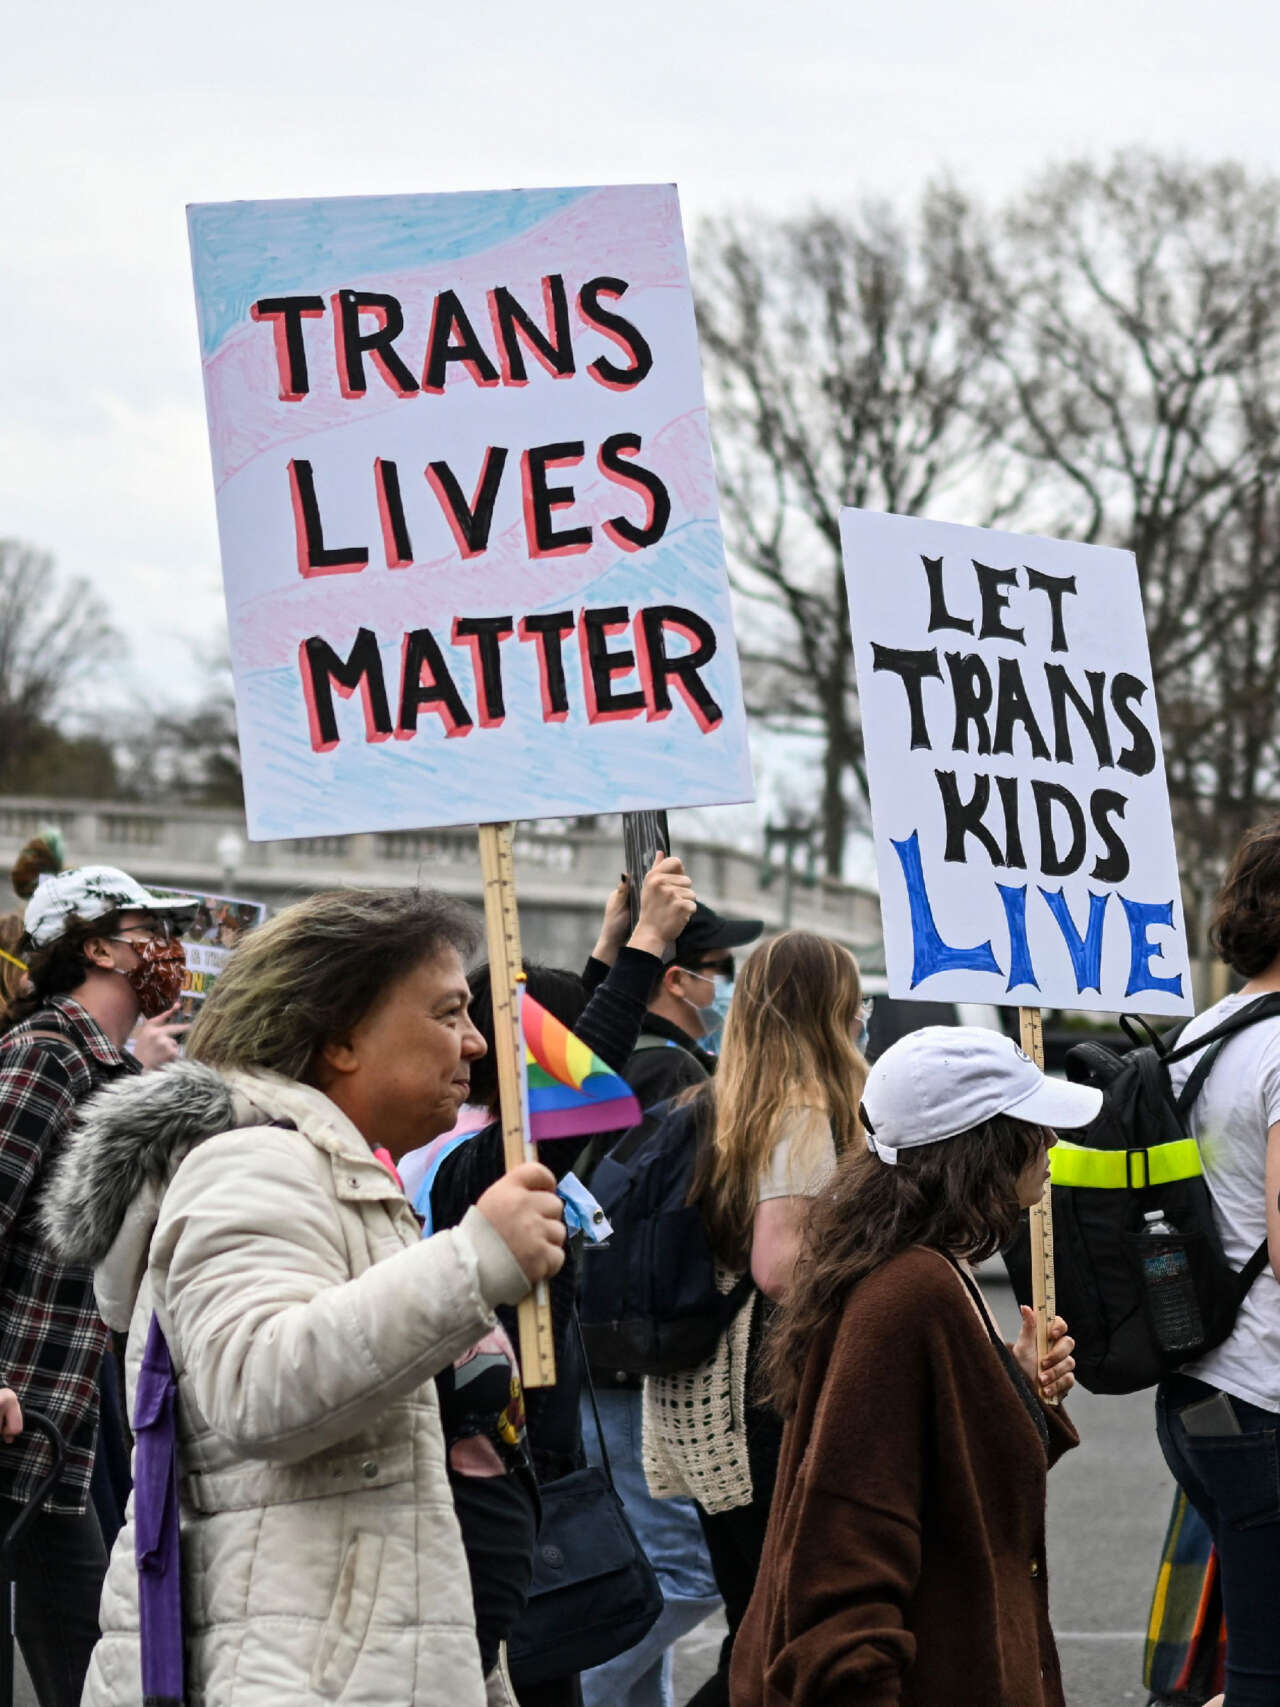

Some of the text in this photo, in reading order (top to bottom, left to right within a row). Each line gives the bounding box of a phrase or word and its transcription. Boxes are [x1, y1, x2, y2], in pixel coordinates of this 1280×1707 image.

[250, 274, 652, 402] TRANS
[286, 432, 671, 578] LIVES
[920, 555, 1077, 653] LET
[299, 605, 723, 753] MATTER
[870, 641, 1156, 776] TRANS
[934, 768, 1129, 884] KIDS
[890, 829, 1183, 998] LIVE
